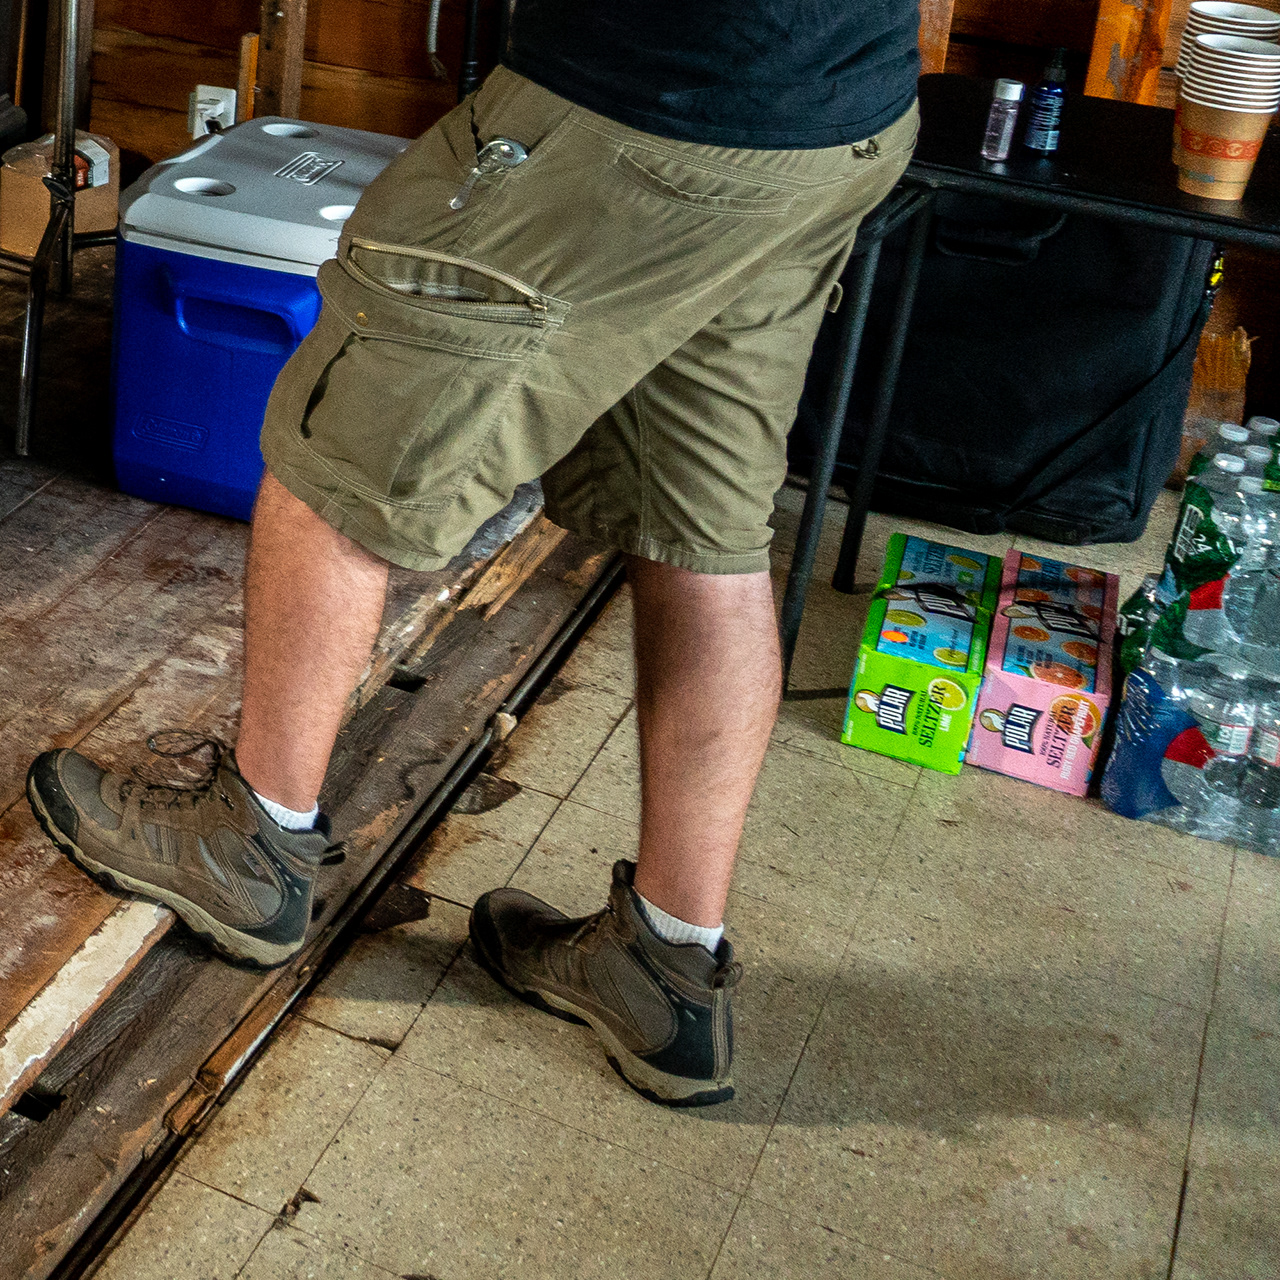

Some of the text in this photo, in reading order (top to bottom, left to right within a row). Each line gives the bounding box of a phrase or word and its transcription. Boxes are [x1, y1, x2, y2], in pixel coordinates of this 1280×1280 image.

[878, 686, 911, 732] POLAR
[918, 684, 946, 748] SELTZER
[938, 713, 953, 733] LIME
[1005, 706, 1037, 751] POLAR
[1069, 699, 1090, 745] GRAPEFRUIT
[1046, 704, 1078, 769] SELTZER
[1066, 745, 1078, 760] RED
